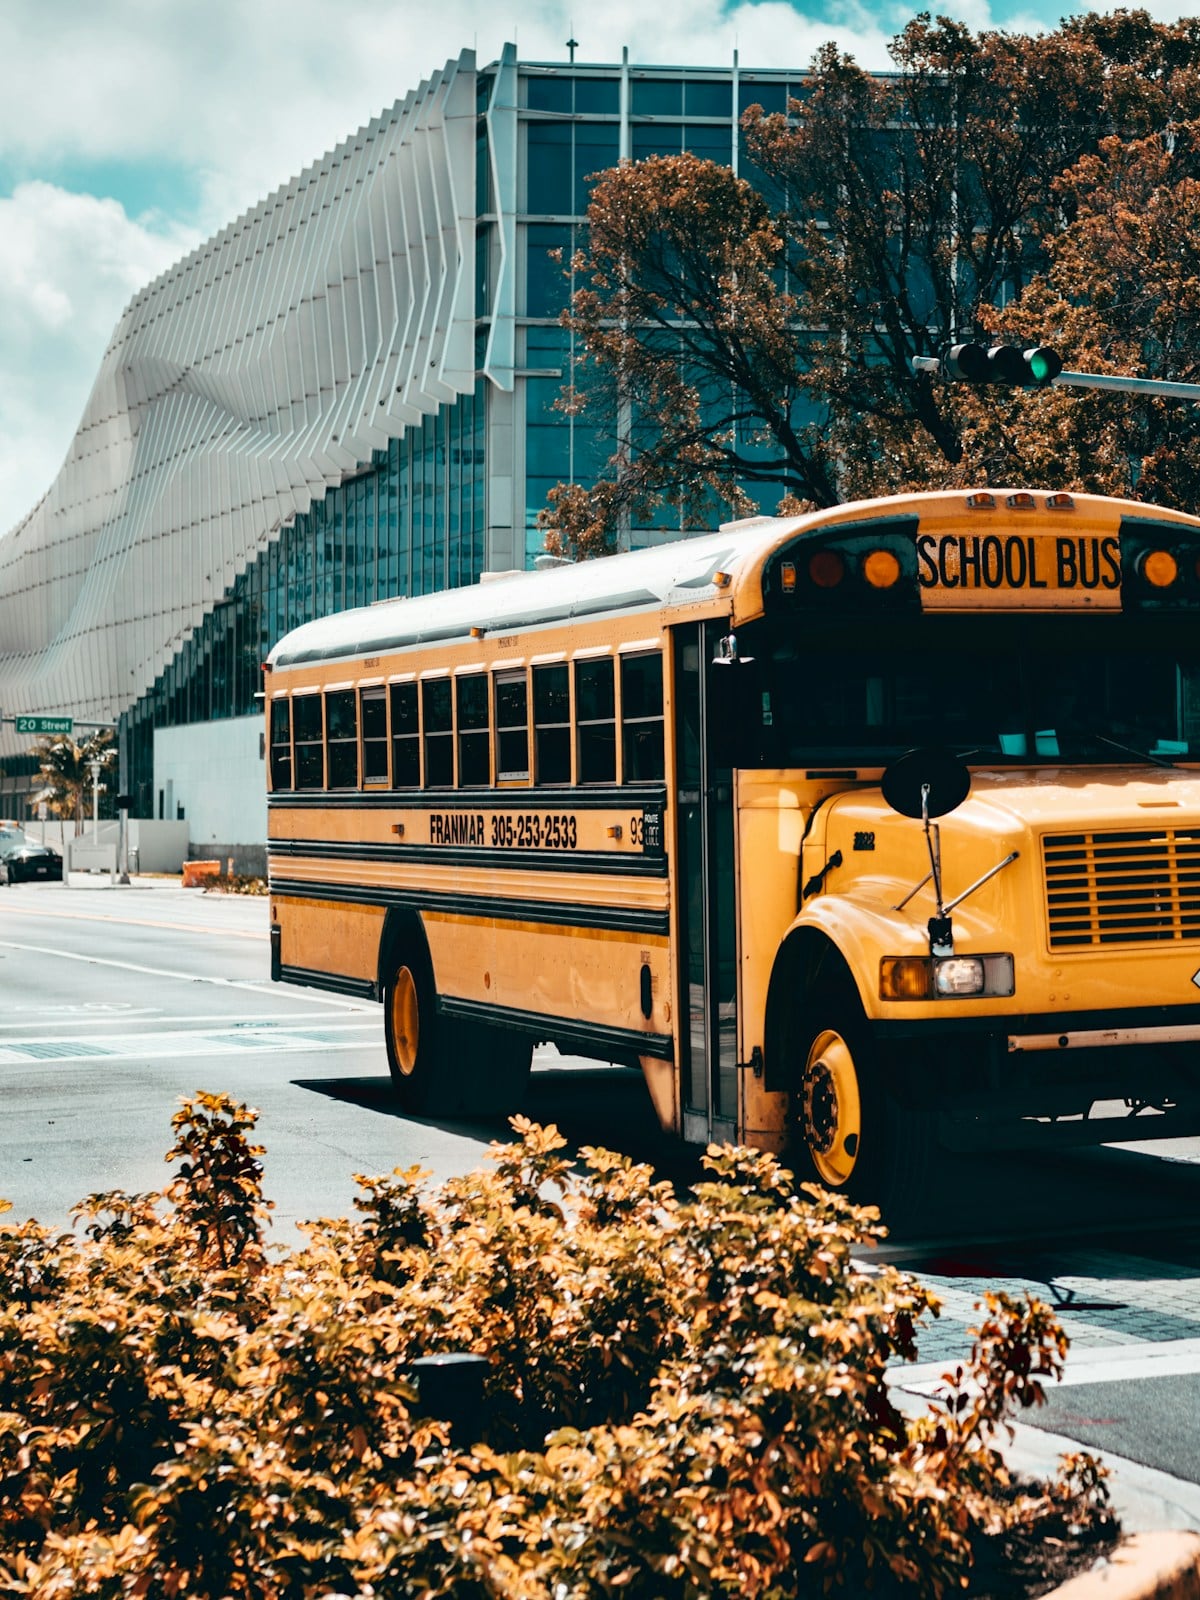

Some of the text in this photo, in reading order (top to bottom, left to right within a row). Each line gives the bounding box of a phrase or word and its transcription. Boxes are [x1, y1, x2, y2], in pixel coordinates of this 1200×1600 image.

[917, 534, 1121, 589] SCHOOL BUS
[20, 719, 70, 731] 20 Street
[430, 814, 577, 848] FRANMAR 305-253-2533
